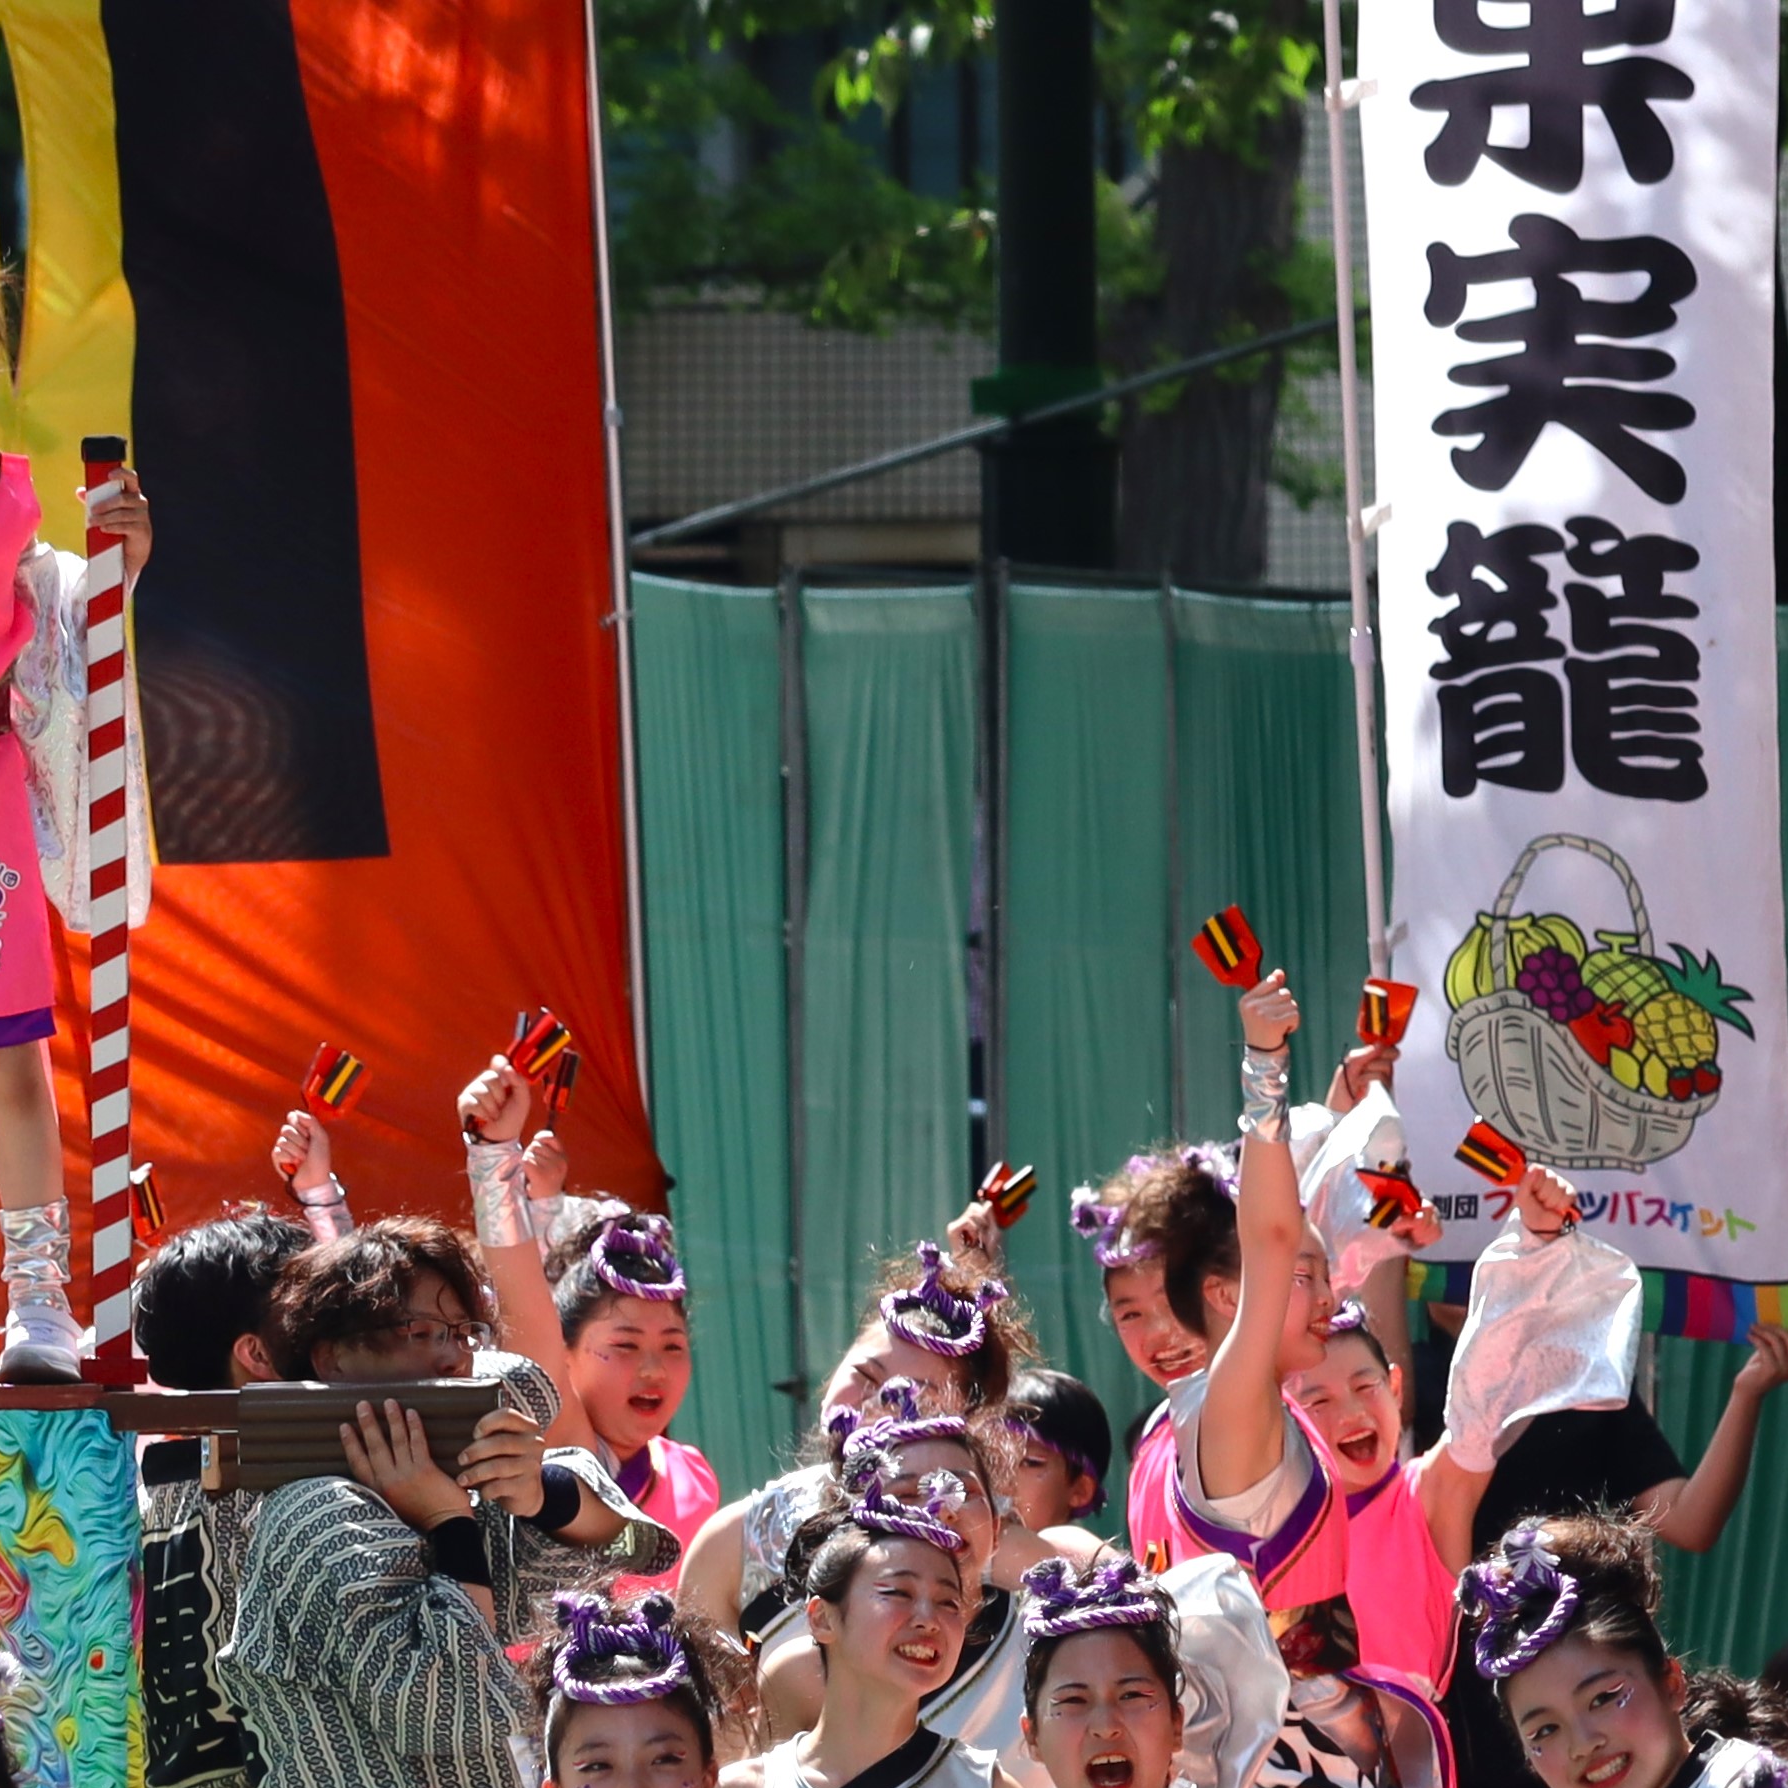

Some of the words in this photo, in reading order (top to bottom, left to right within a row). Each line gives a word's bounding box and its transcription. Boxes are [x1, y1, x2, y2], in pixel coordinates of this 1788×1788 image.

[1410, 0, 1708, 802] 果実籠
[1431, 1187, 1757, 1242] 劇団フツバスケット
